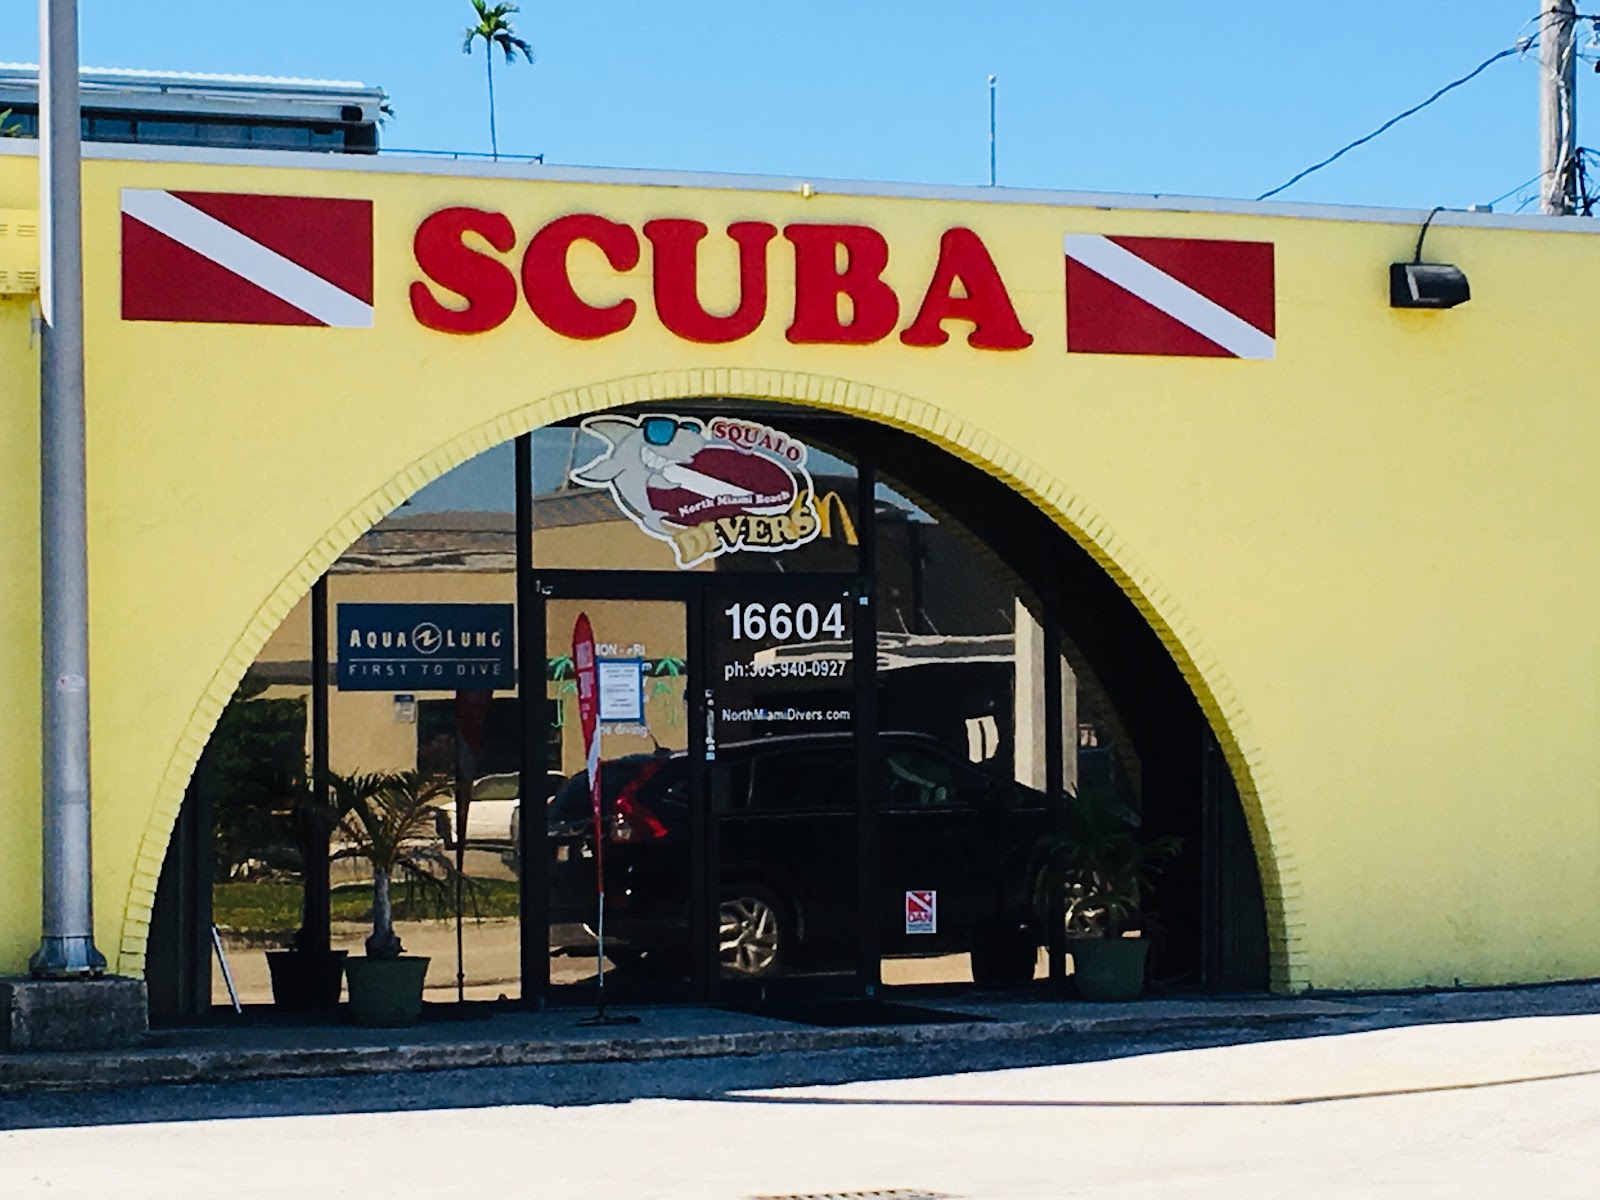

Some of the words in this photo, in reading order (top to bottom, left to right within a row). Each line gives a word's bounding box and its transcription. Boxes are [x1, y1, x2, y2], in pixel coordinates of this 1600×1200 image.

[409, 206, 1034, 351] SCUBA
[714, 421, 801, 461] SQUALO
[679, 497, 715, 518] North
[716, 492, 753, 507] Miami
[755, 490, 791, 505] Beach
[673, 506, 816, 563] DIVERS
[725, 602, 845, 640] 16604
[350, 629, 407, 649] AQUA
[447, 630, 501, 648] LUNG
[349, 664, 407, 676] FIRST
[421, 664, 443, 676] TO
[456, 664, 501, 676] DIVE
[721, 708, 851, 722] NorthMiamiDivers.com
